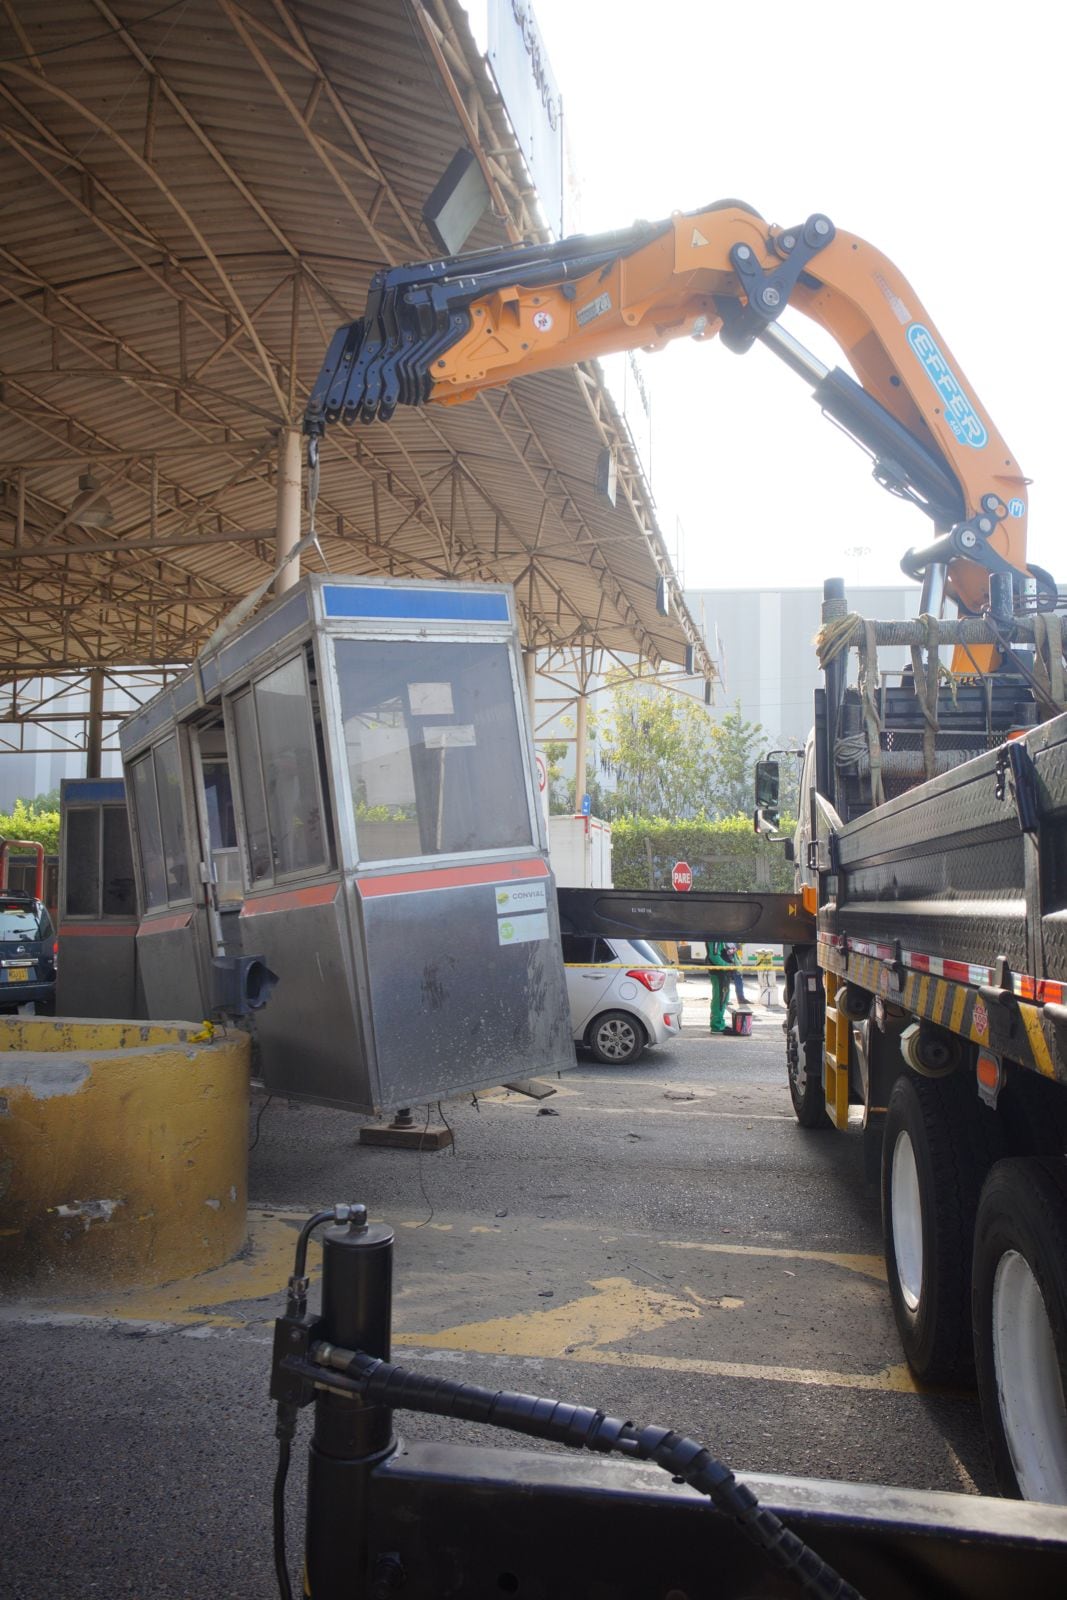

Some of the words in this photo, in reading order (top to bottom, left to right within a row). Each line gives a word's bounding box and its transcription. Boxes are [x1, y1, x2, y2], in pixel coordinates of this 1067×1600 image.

[914, 331, 982, 440] EFFER
[674, 872, 691, 885] PARE
[512, 890, 545, 900] CONVIAL
